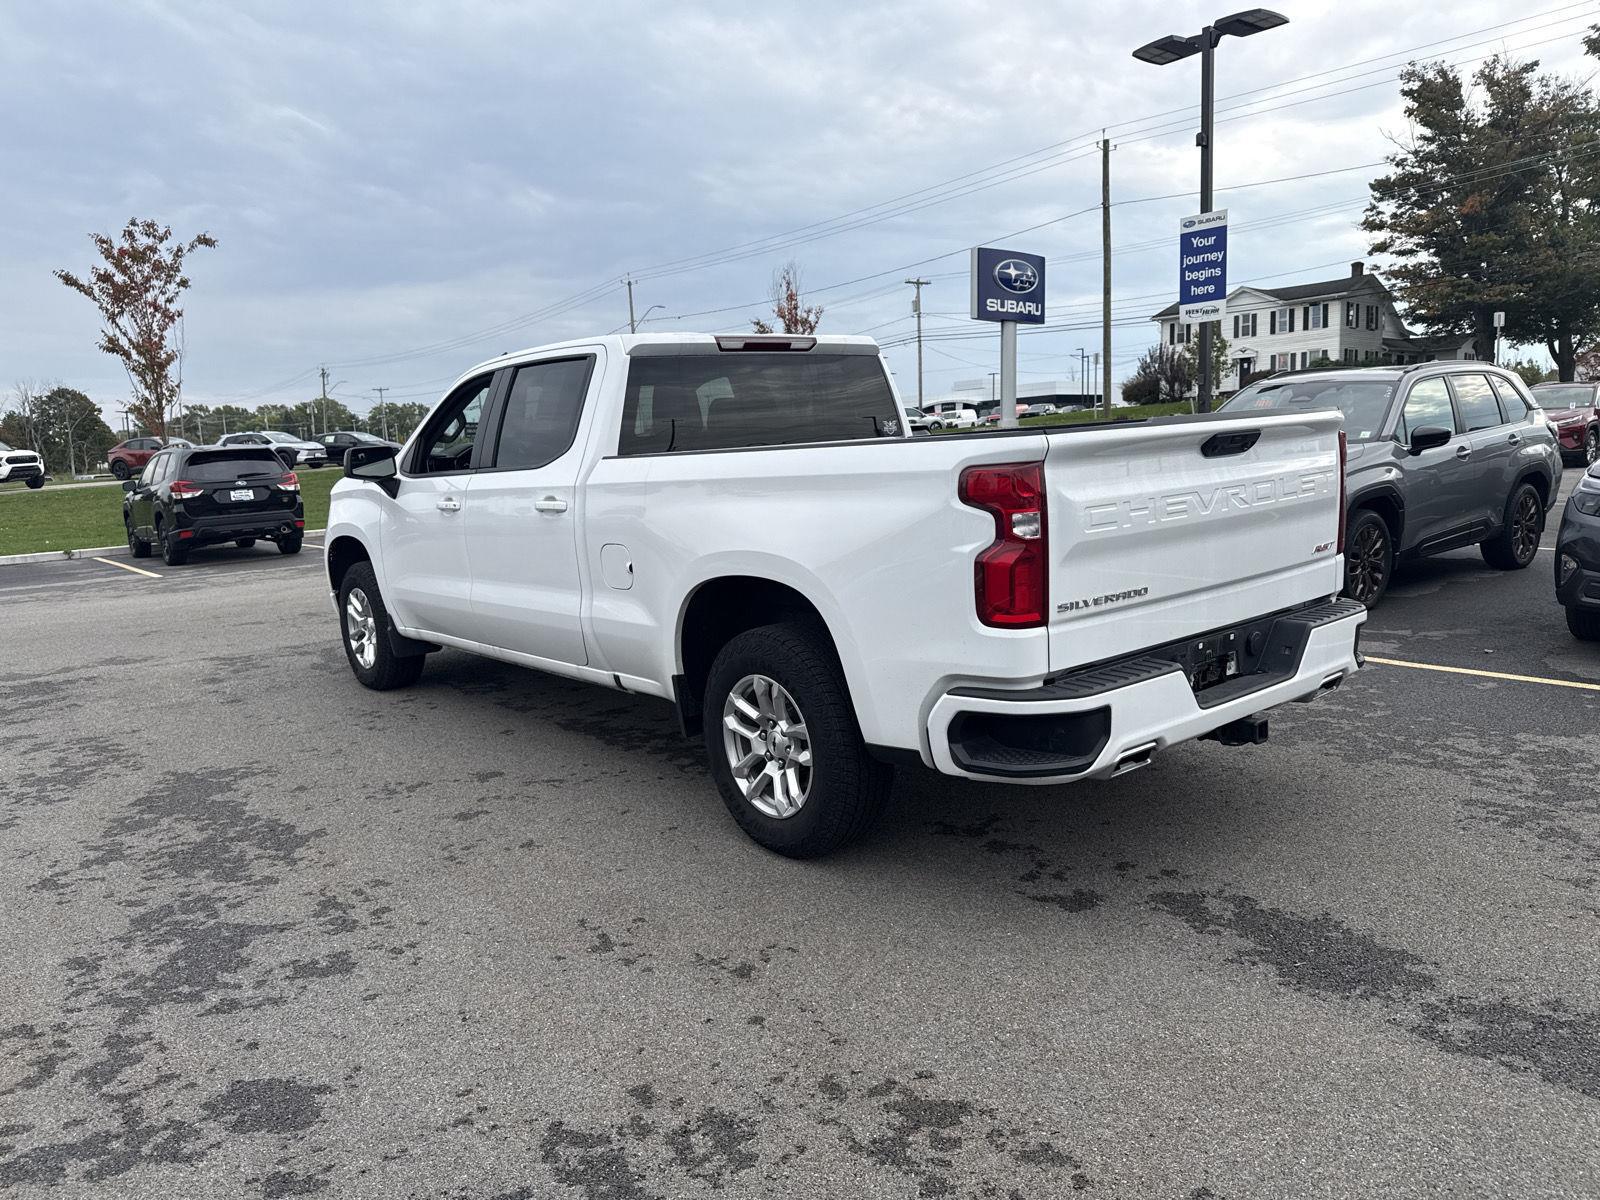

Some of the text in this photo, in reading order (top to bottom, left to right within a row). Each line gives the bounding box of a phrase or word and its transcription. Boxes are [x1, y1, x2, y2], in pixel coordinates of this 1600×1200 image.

[1198, 215, 1225, 224] SUBARU
[1191, 236, 1216, 247] Your
[1183, 251, 1224, 268] journey
[1185, 267, 1221, 281] begins
[1190, 284, 1215, 296] here
[986, 298, 1041, 315] SUBARU
[1084, 469, 1334, 533] CHEVROLET
[1312, 541, 1335, 554] RST
[1056, 586, 1148, 614] SILVERADO
